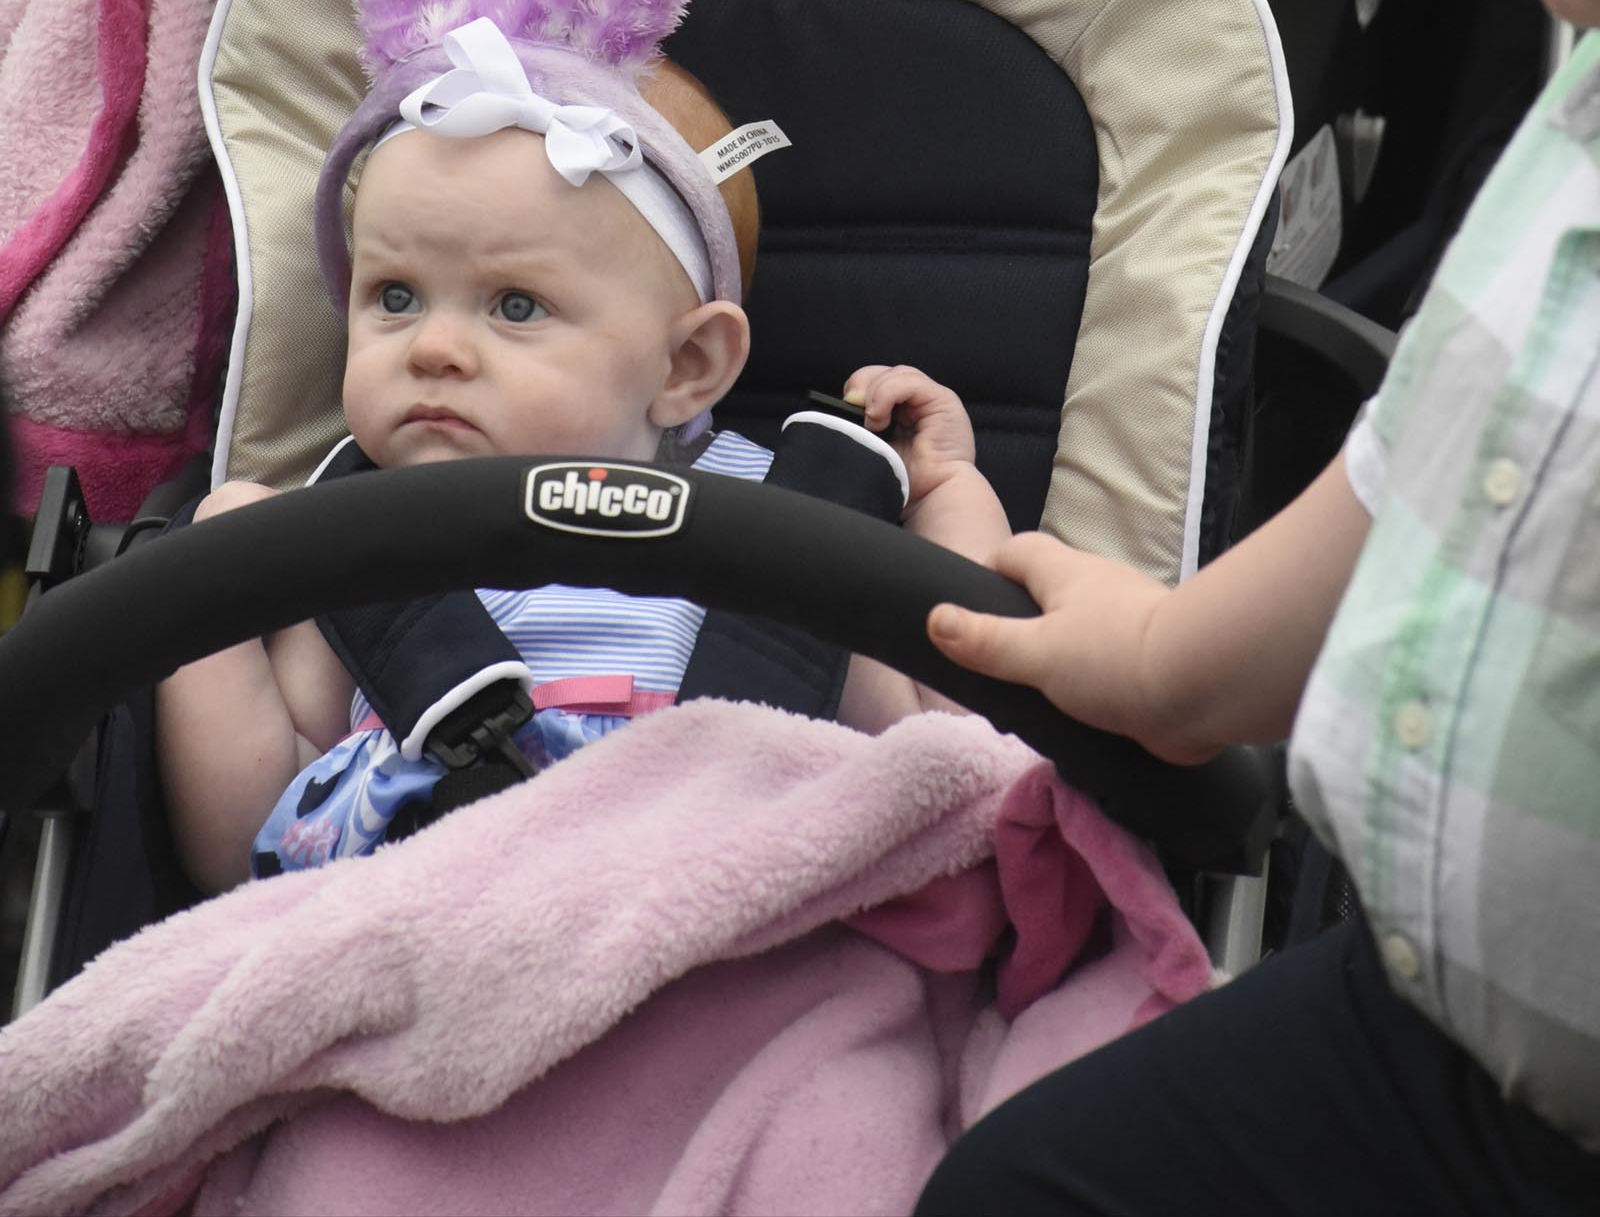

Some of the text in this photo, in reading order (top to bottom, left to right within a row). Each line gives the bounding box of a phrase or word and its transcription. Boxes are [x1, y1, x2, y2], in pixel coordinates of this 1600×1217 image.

[716, 127, 769, 159] MADE IN CHINA
[538, 467, 673, 521] chicco
